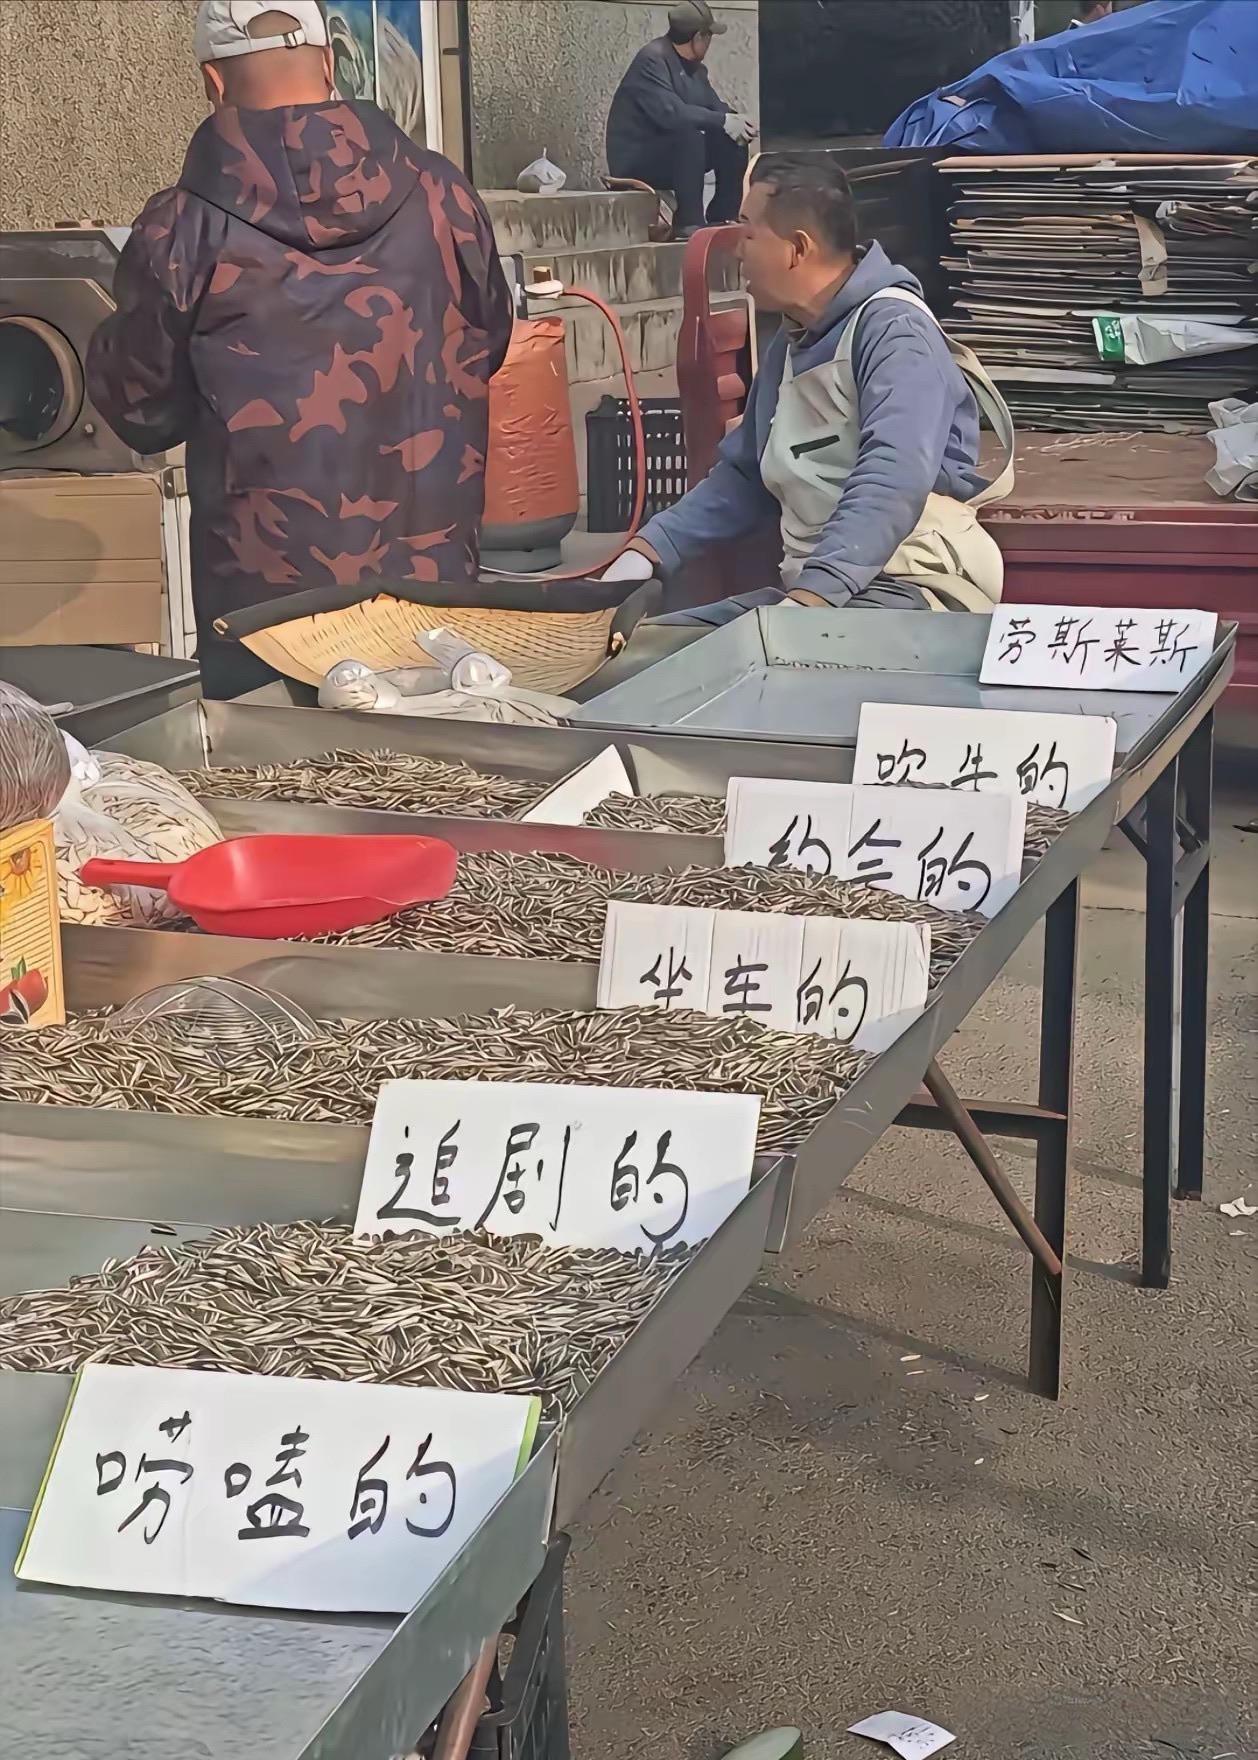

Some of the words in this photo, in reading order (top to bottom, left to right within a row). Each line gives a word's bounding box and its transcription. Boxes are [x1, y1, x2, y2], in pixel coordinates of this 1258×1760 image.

[998, 617, 1199, 674] 劳斯莱斯
[876, 738, 1069, 809] 吹牛的
[376, 1118, 690, 1244] 追剧的
[95, 1410, 457, 1545] 唠嗑的
